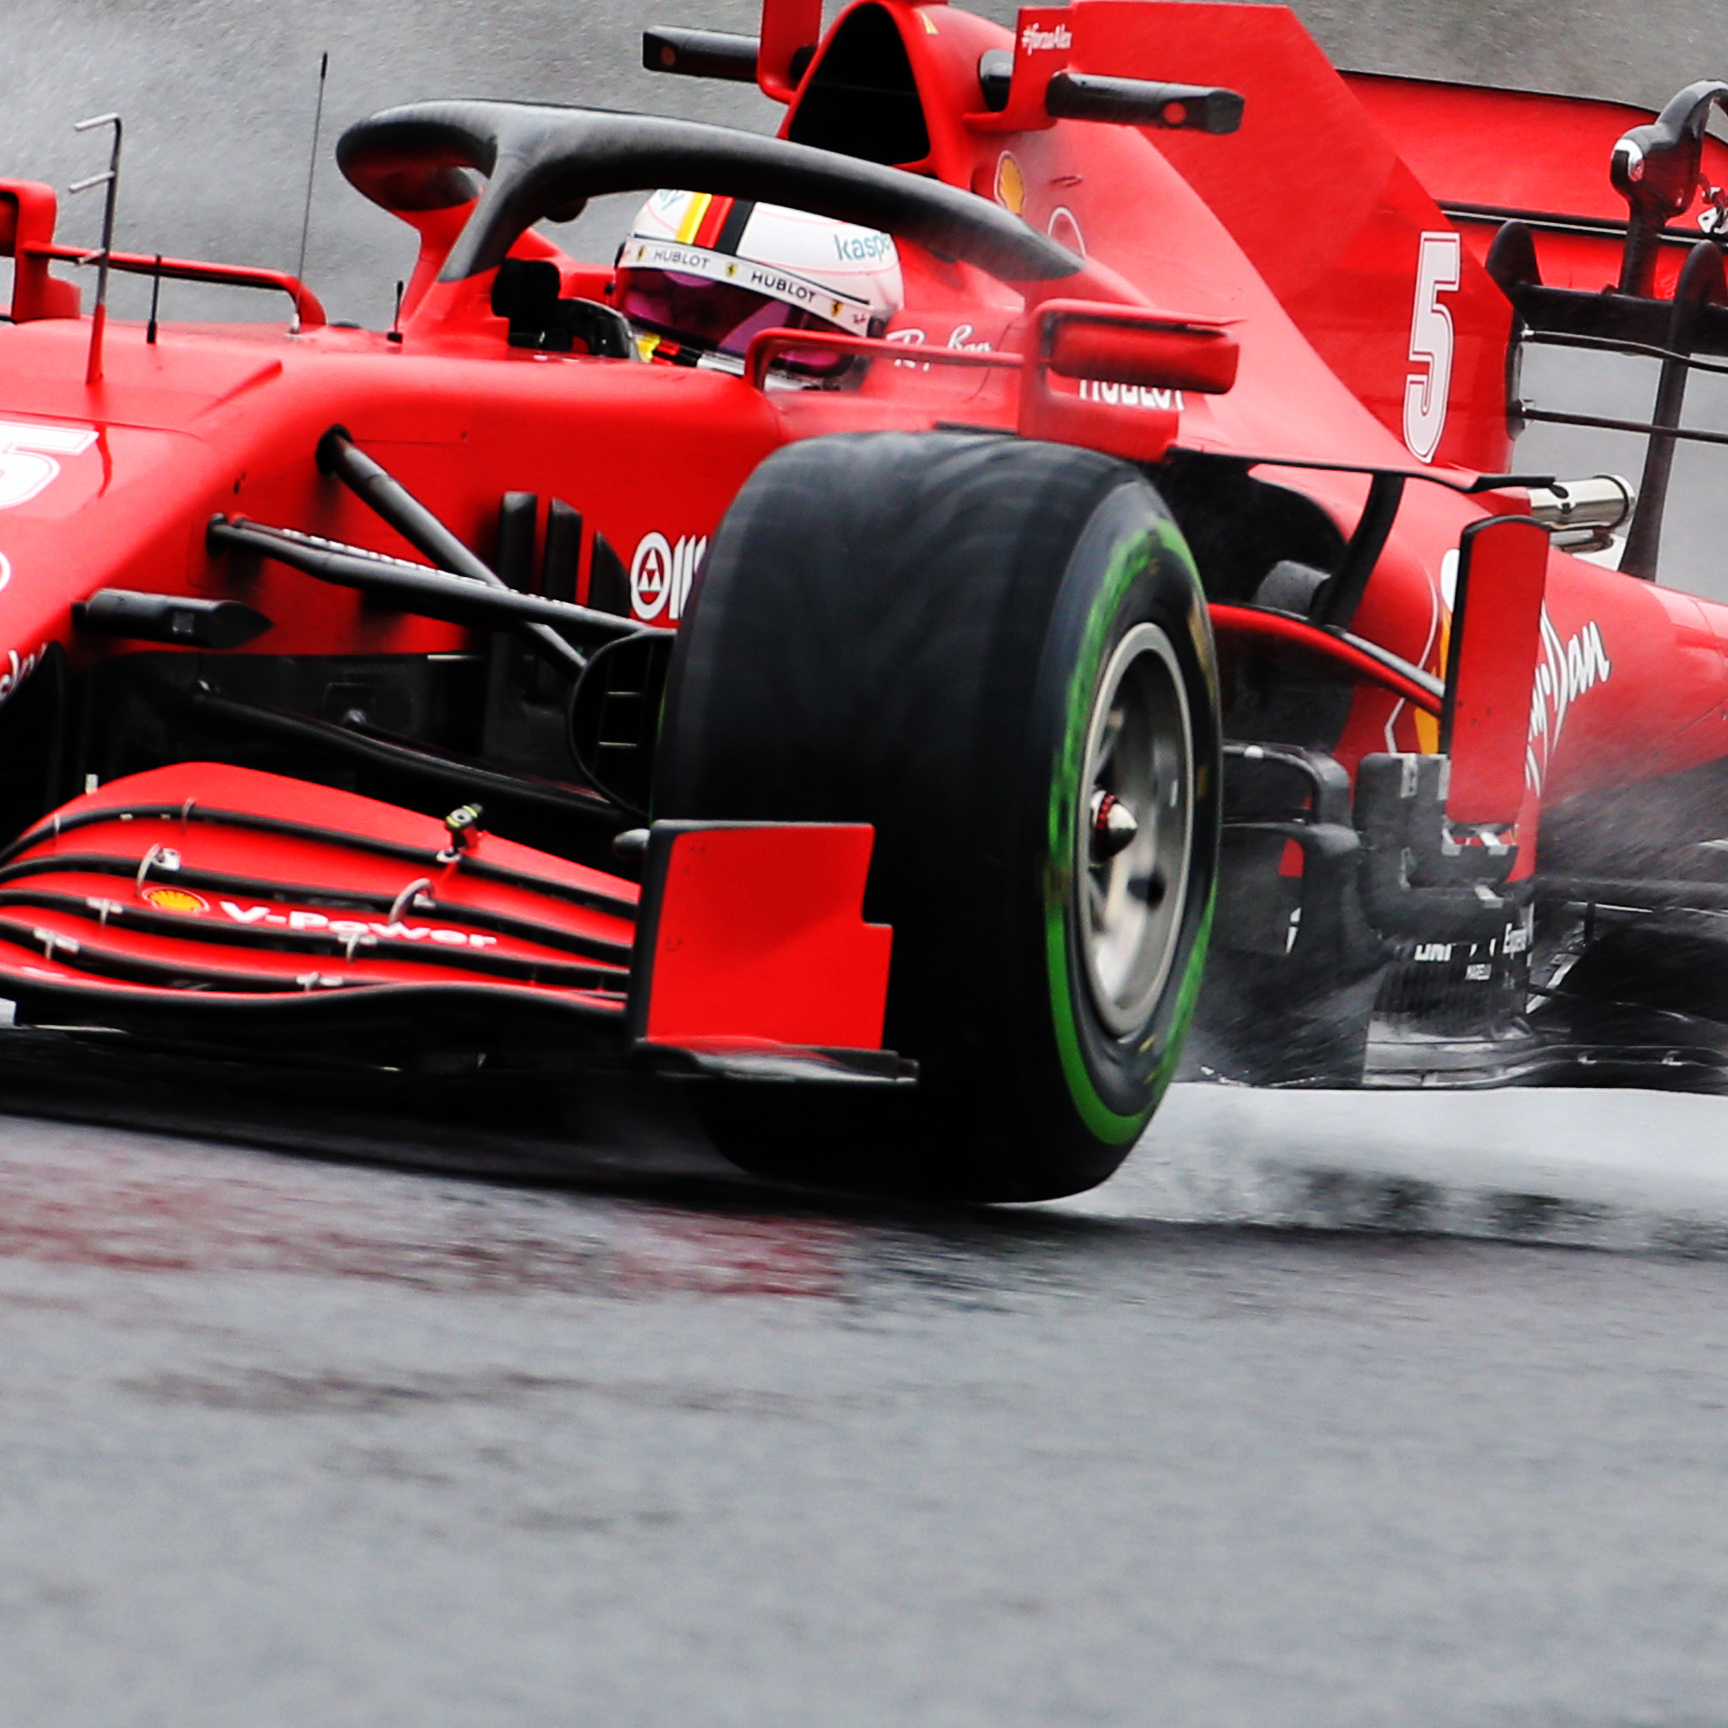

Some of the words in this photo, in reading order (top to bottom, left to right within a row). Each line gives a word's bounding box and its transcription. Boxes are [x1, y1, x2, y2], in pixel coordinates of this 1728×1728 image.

[652, 248, 711, 270] HUBLOT
[750, 270, 818, 304] HUBLOT
[1402, 231, 1461, 464] 5
[219, 900, 498, 948] V-Power
